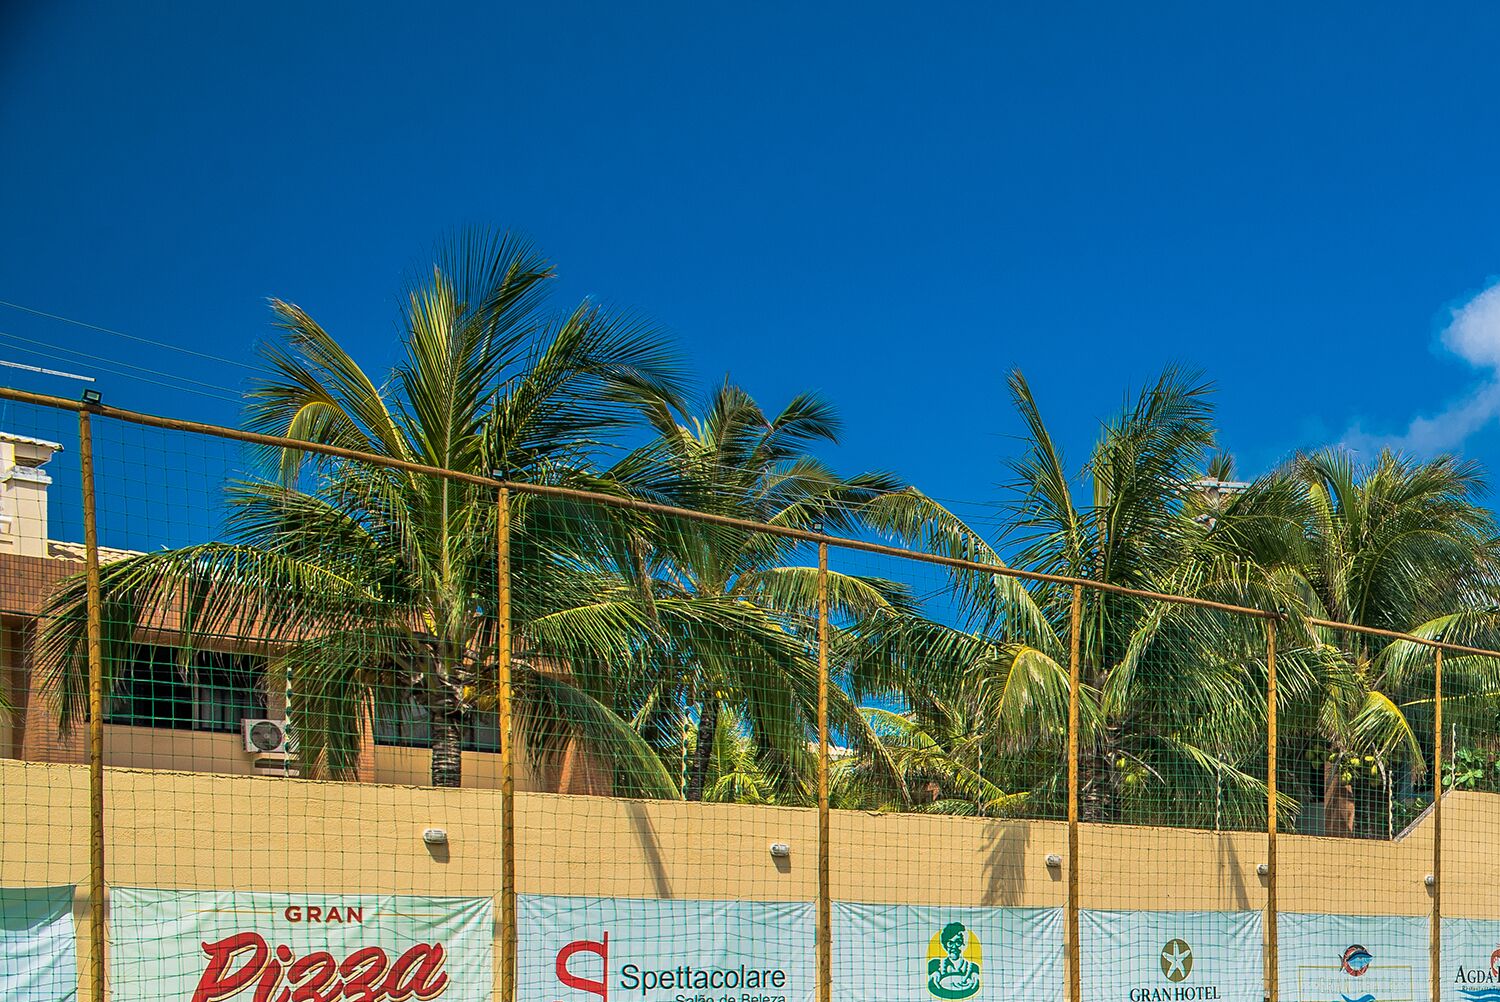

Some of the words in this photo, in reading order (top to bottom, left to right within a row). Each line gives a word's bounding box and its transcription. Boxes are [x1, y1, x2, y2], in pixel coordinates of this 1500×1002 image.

[284, 905, 364, 924] GRAN
[620, 963, 787, 996] Spettacolare
[1454, 964, 1493, 984] AGDA
[1129, 987, 1172, 1002] GRAN
[1174, 986, 1222, 1001] HOTEL
